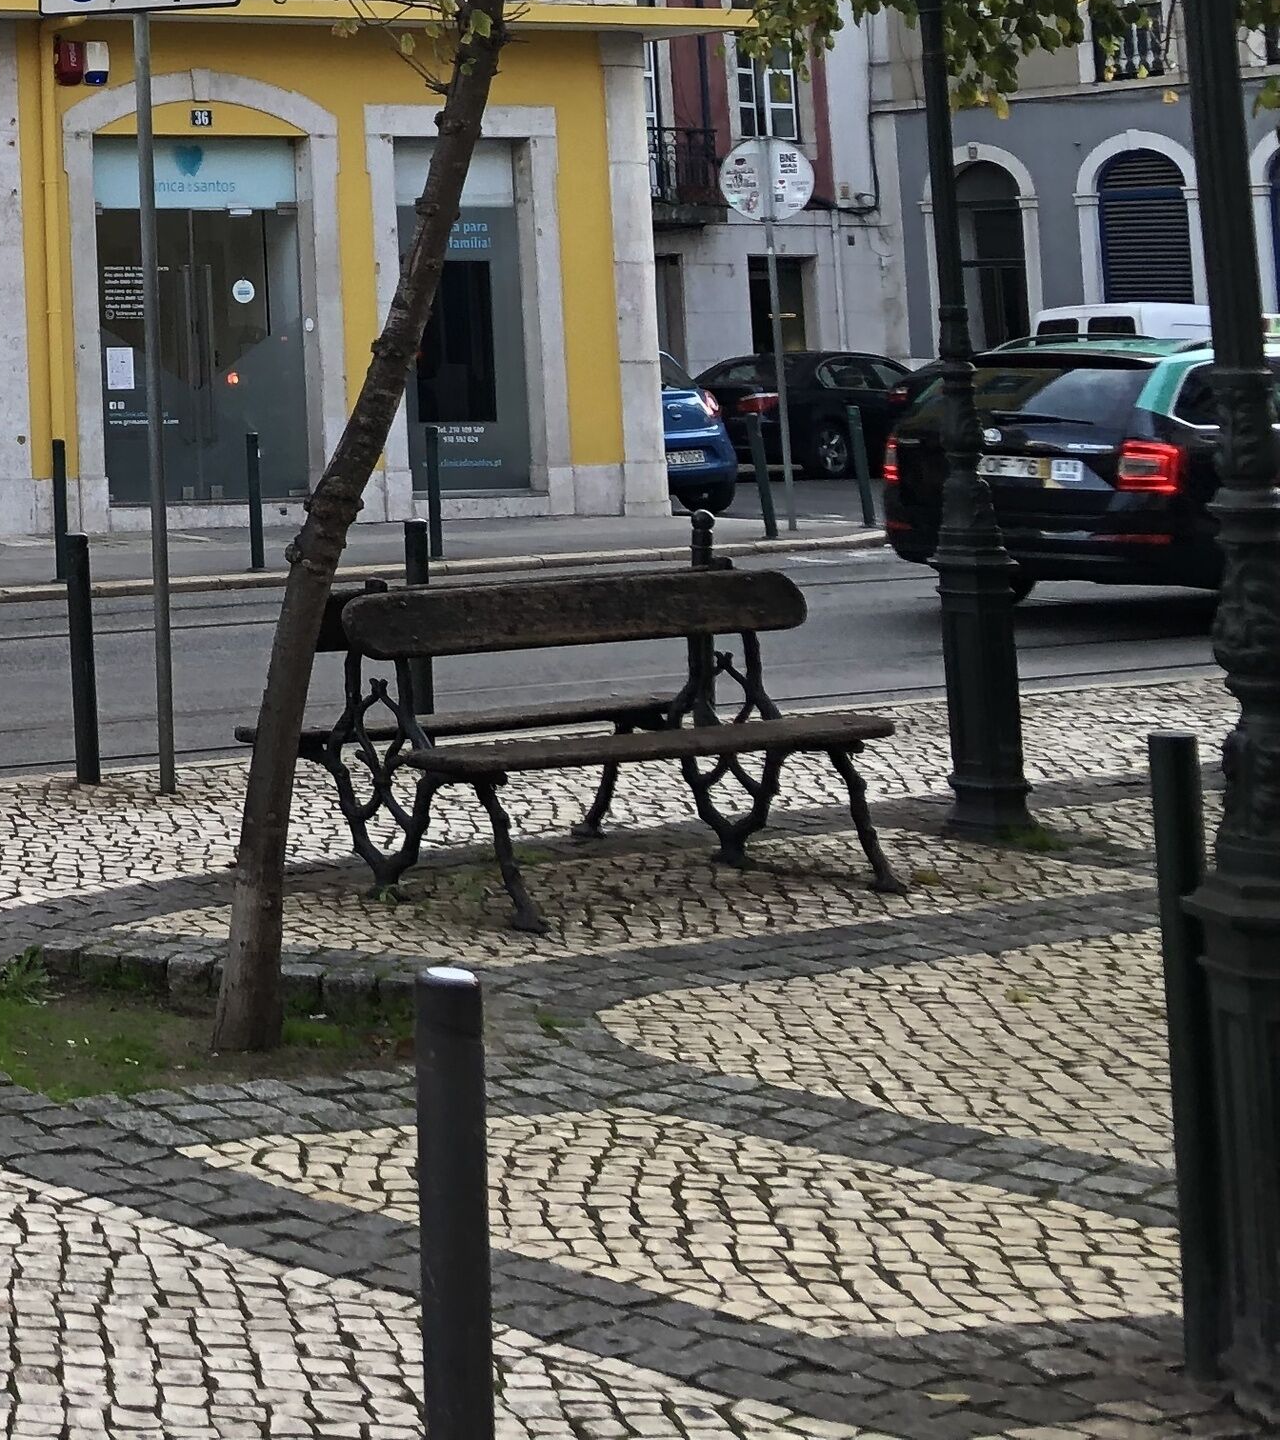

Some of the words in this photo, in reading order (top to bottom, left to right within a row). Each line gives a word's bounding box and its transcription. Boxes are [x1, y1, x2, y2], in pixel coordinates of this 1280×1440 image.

[194, 111, 209, 126] 36
[193, 180, 236, 192] santos
[463, 223, 488, 235] para
